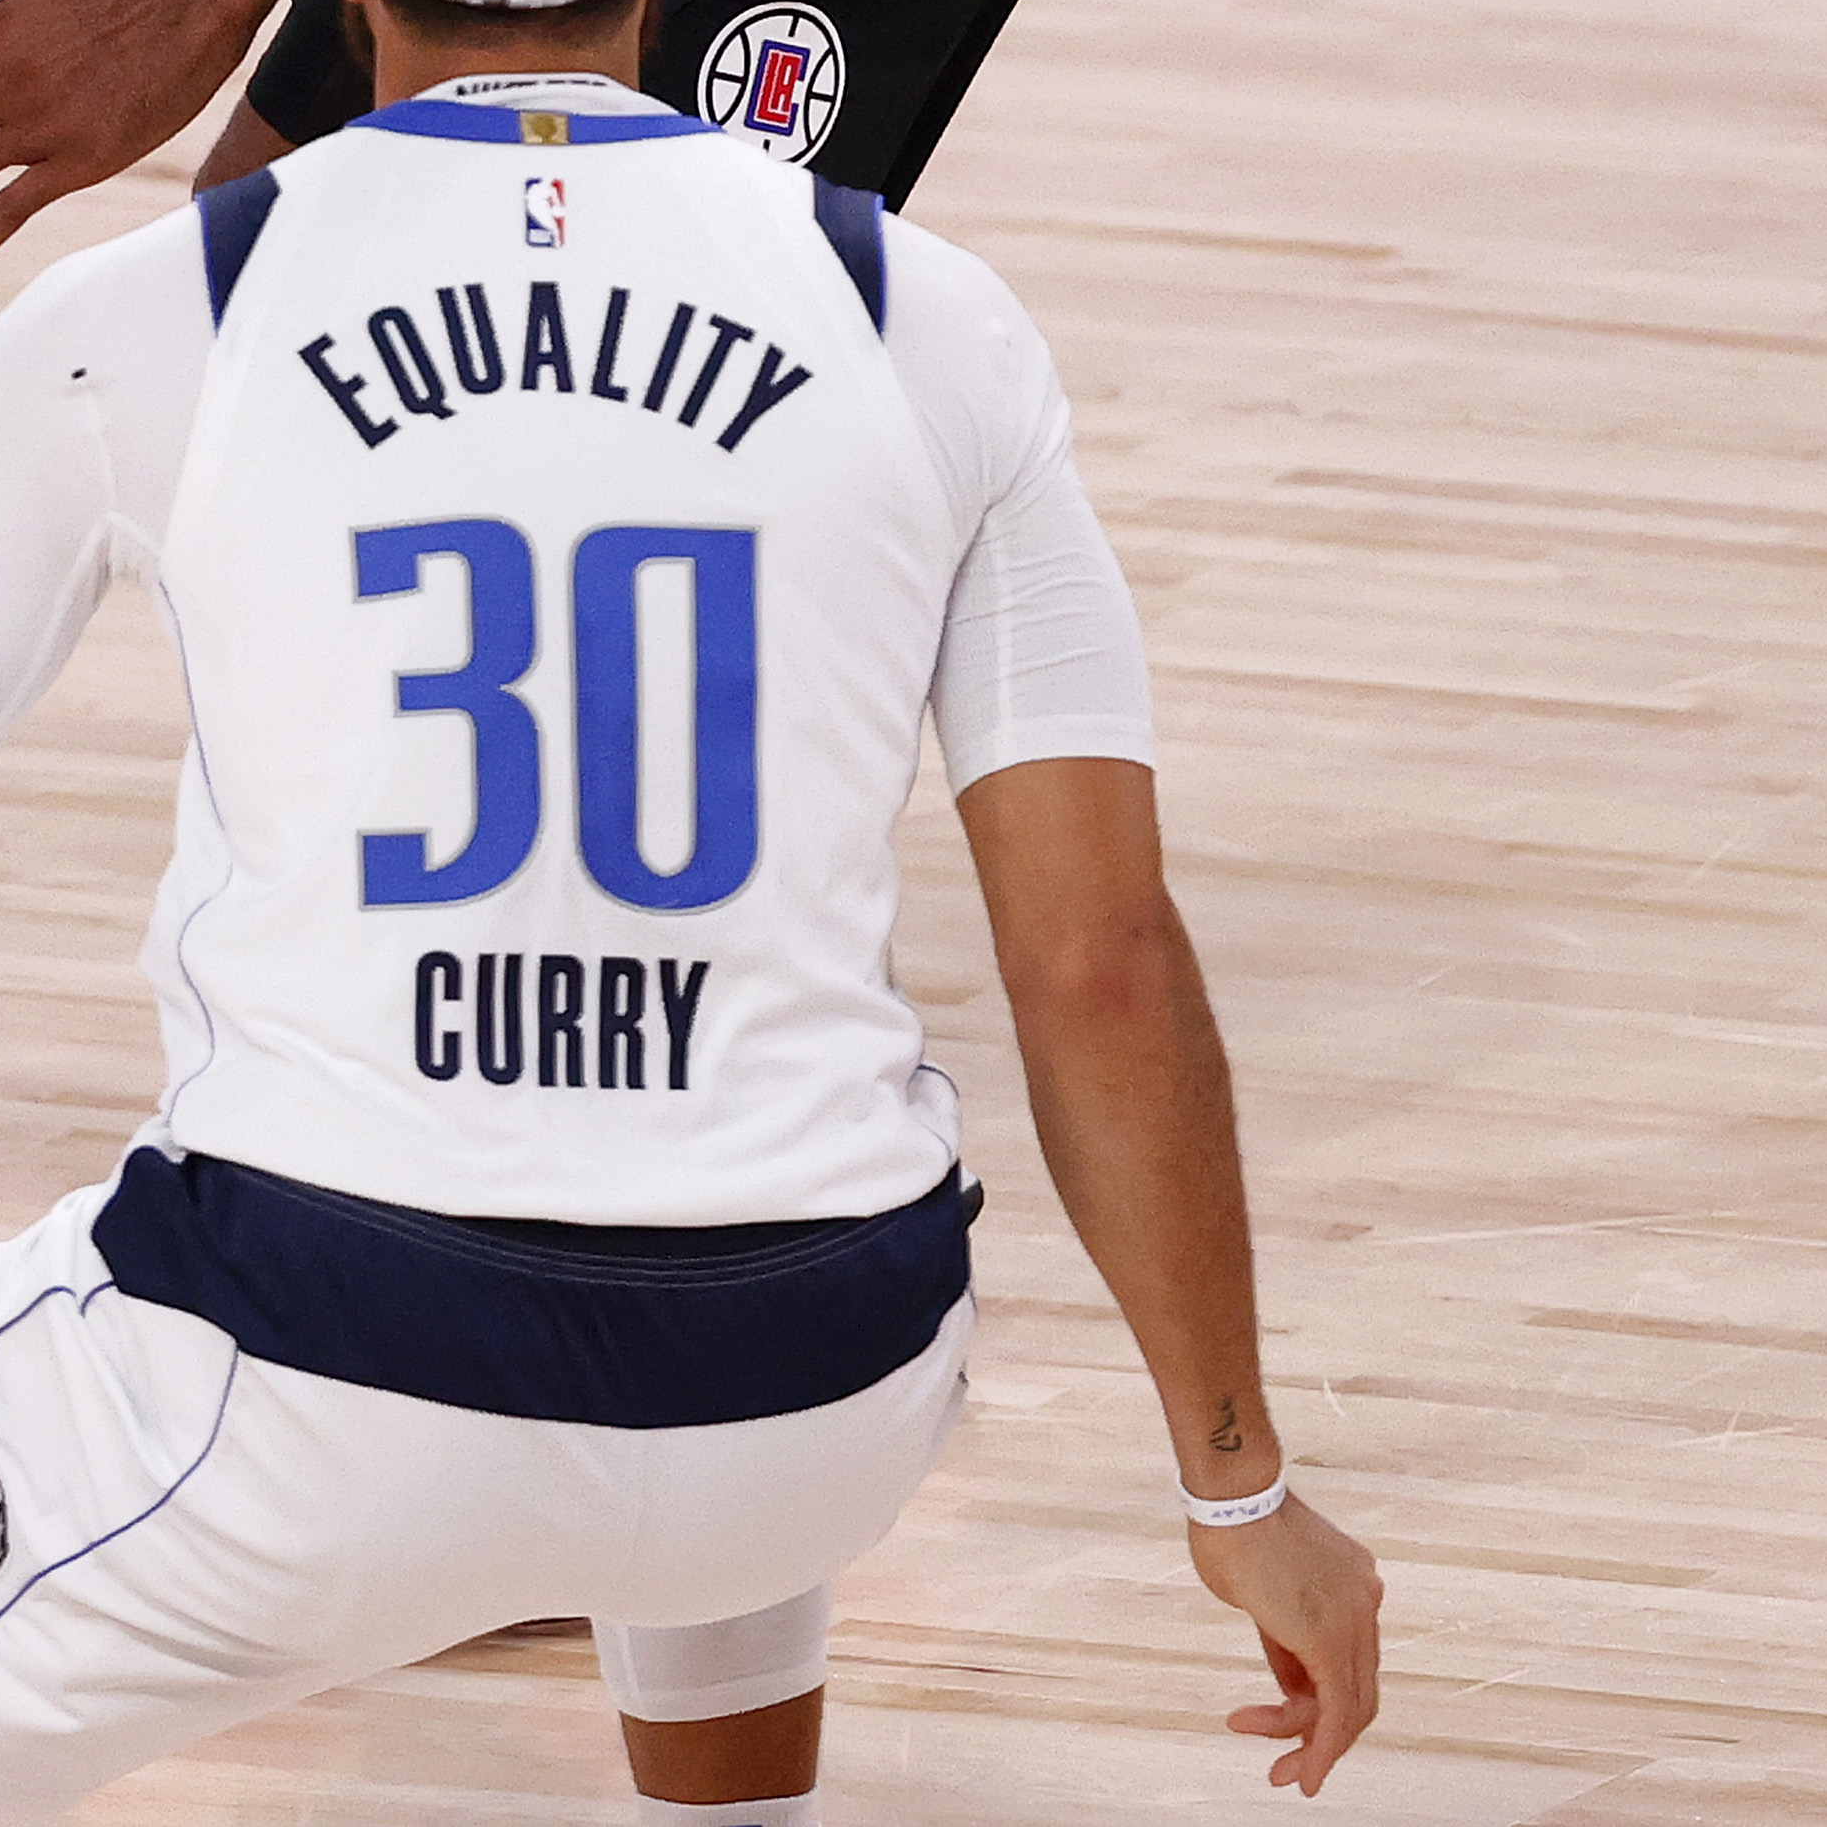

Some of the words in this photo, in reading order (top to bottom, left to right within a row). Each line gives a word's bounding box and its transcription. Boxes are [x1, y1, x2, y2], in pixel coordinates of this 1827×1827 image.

[298, 280, 814, 454] EQUALITY
[348, 514, 763, 917] 30
[414, 950, 711, 1091] CURRY
